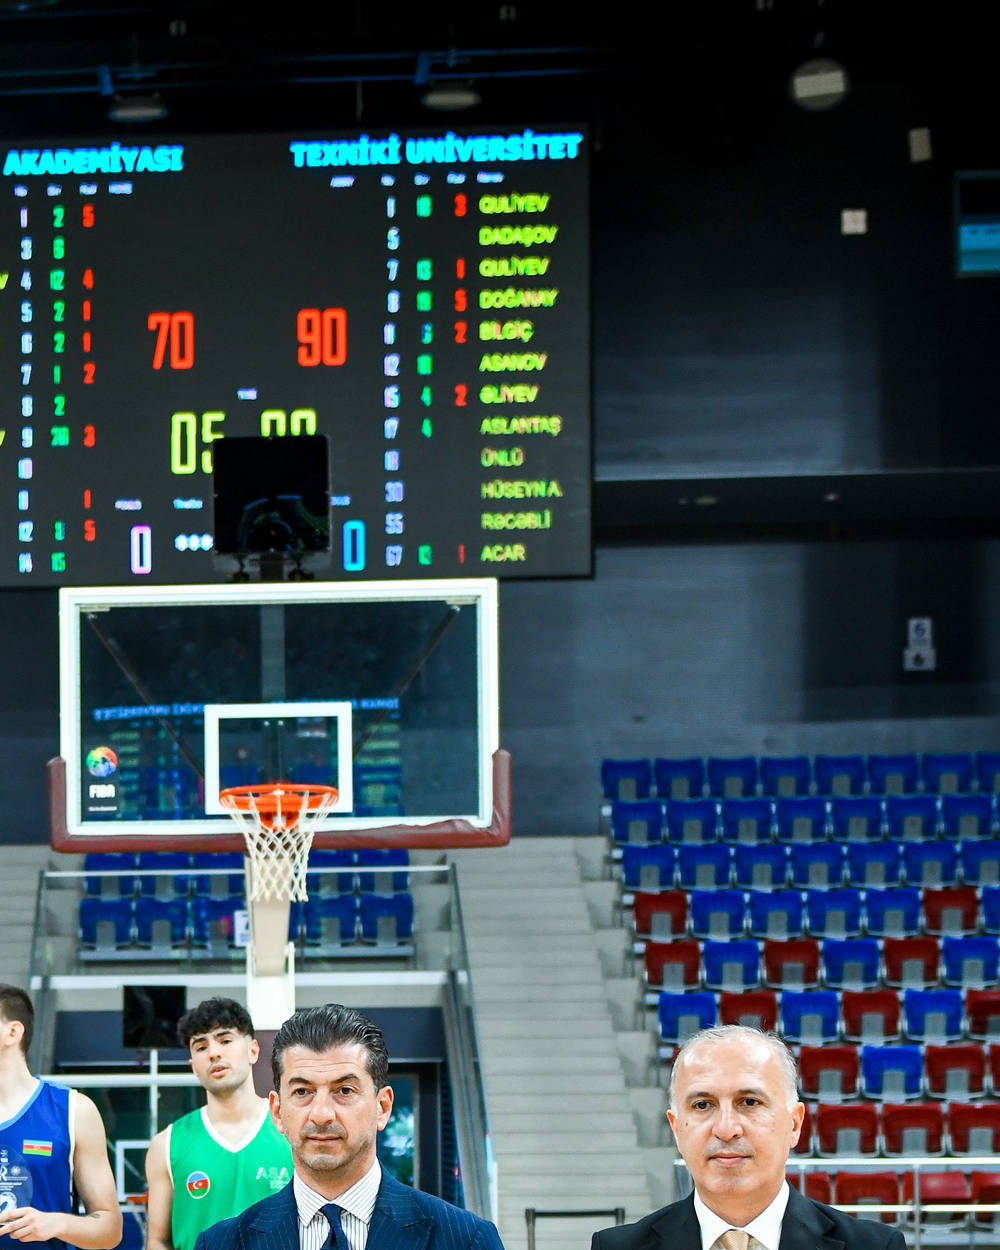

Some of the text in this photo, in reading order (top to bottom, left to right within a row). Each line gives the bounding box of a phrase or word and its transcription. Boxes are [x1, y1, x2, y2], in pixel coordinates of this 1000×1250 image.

[3, 141, 184, 176] AKADEMİYASI
[290, 128, 583, 167] TEXNİKİ UNİVERSİTET
[20, 208, 27, 227] 1
[53, 205, 64, 227] 2
[83, 204, 94, 227] 5
[387, 196, 395, 218] 1
[21, 237, 32, 260] 3
[387, 226, 400, 250] 5
[21, 270, 31, 290] 4
[82, 269, 94, 289] 4
[387, 258, 399, 281] 7
[456, 258, 465, 279] 1
[21, 300, 32, 322] 5
[54, 300, 64, 322] 2
[83, 300, 91, 320] 1
[455, 288, 467, 312] 5
[54, 331, 64, 353] 2
[83, 332, 91, 352] 1
[148, 311, 194, 370] 70
[297, 307, 347, 367] 90
[454, 320, 467, 343] 2
[21, 362, 32, 385] 7
[54, 365, 60, 384] 1
[84, 362, 96, 384] 2
[54, 394, 65, 416] 2
[421, 386, 432, 406] 4
[455, 384, 467, 407] 2
[83, 425, 95, 447] 3
[421, 418, 432, 438] 4
[171, 411, 225, 474] 05
[84, 489, 91, 509] 1
[84, 519, 96, 541] 5
[385, 511, 404, 534] 55
[130, 524, 152, 574] 0
[342, 520, 366, 571] 0
[459, 544, 464, 563] 1
[480, 543, 526, 562] ACAR
